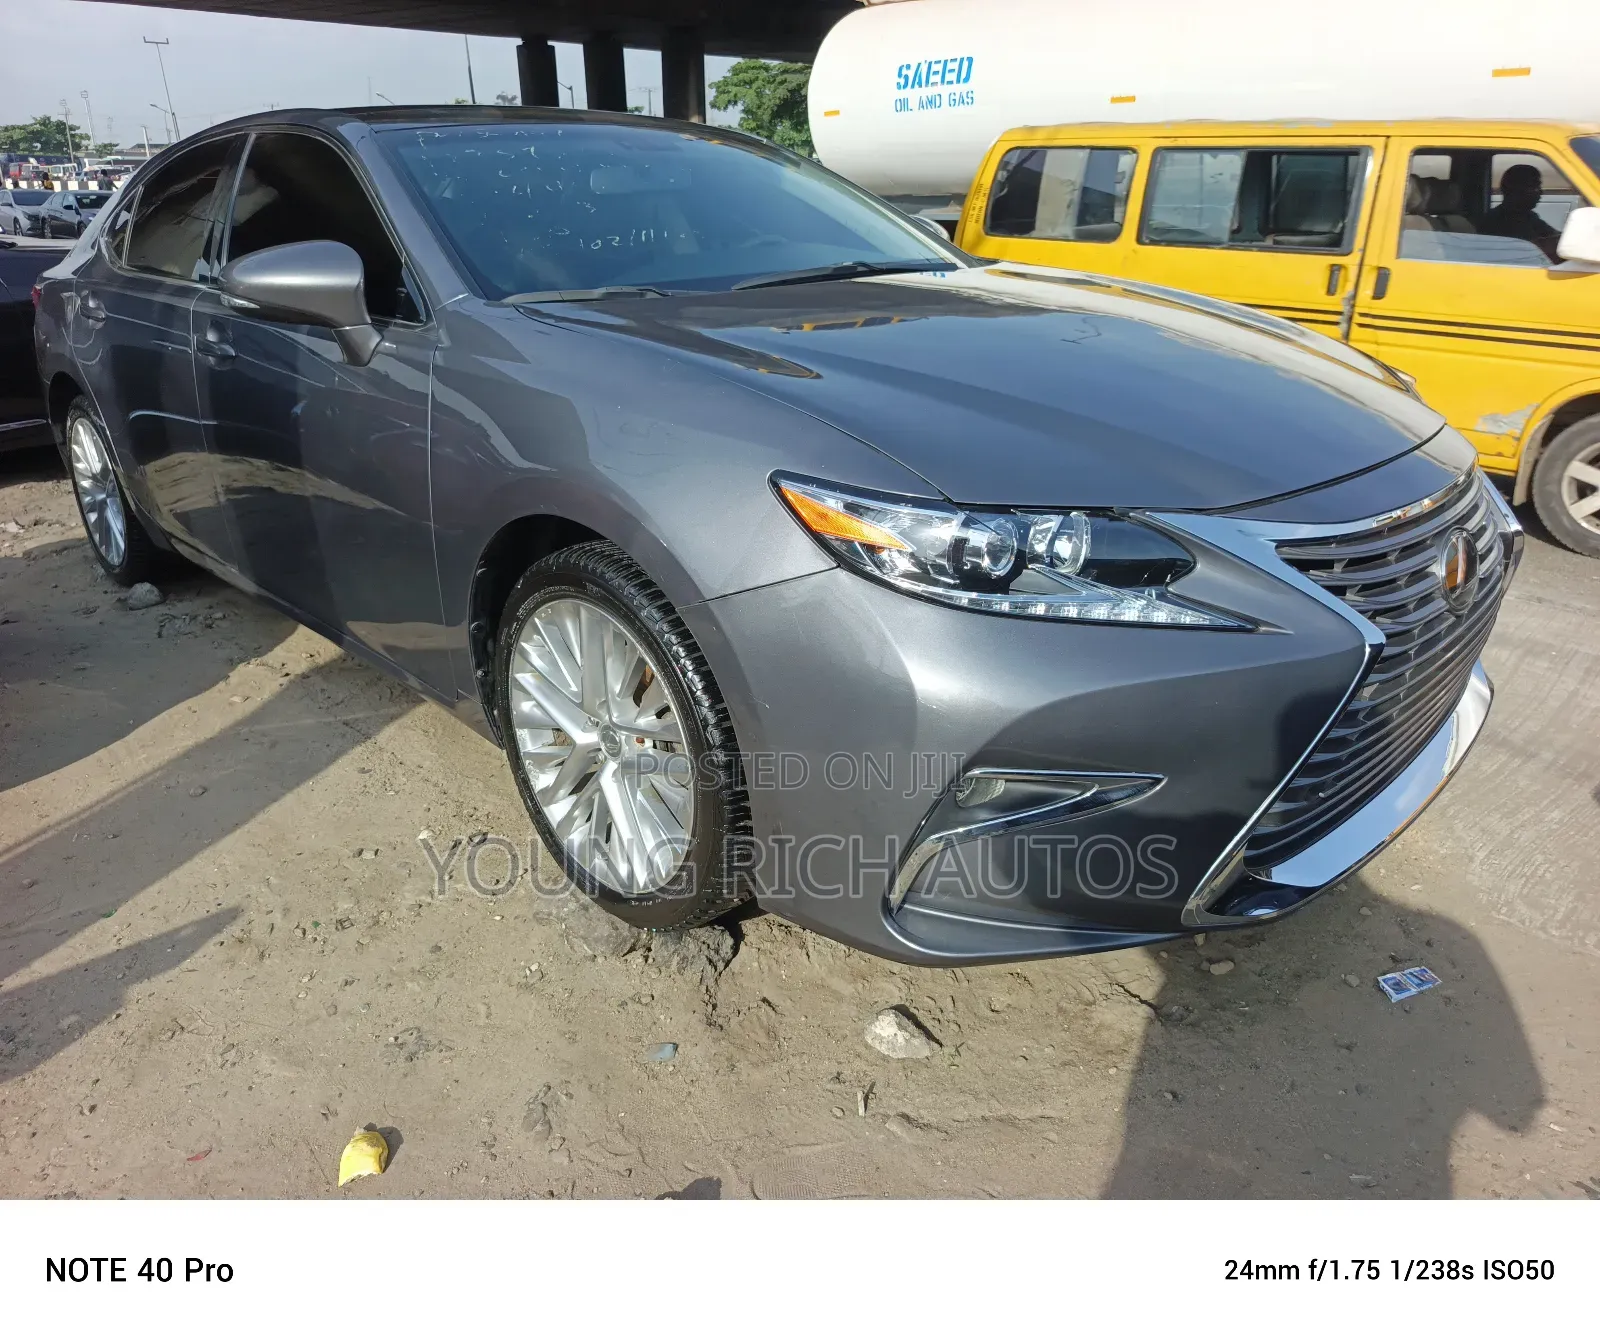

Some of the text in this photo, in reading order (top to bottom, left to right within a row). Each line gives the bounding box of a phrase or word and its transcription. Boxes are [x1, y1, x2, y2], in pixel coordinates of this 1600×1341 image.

[894, 90, 974, 113] OIL AND GAS
